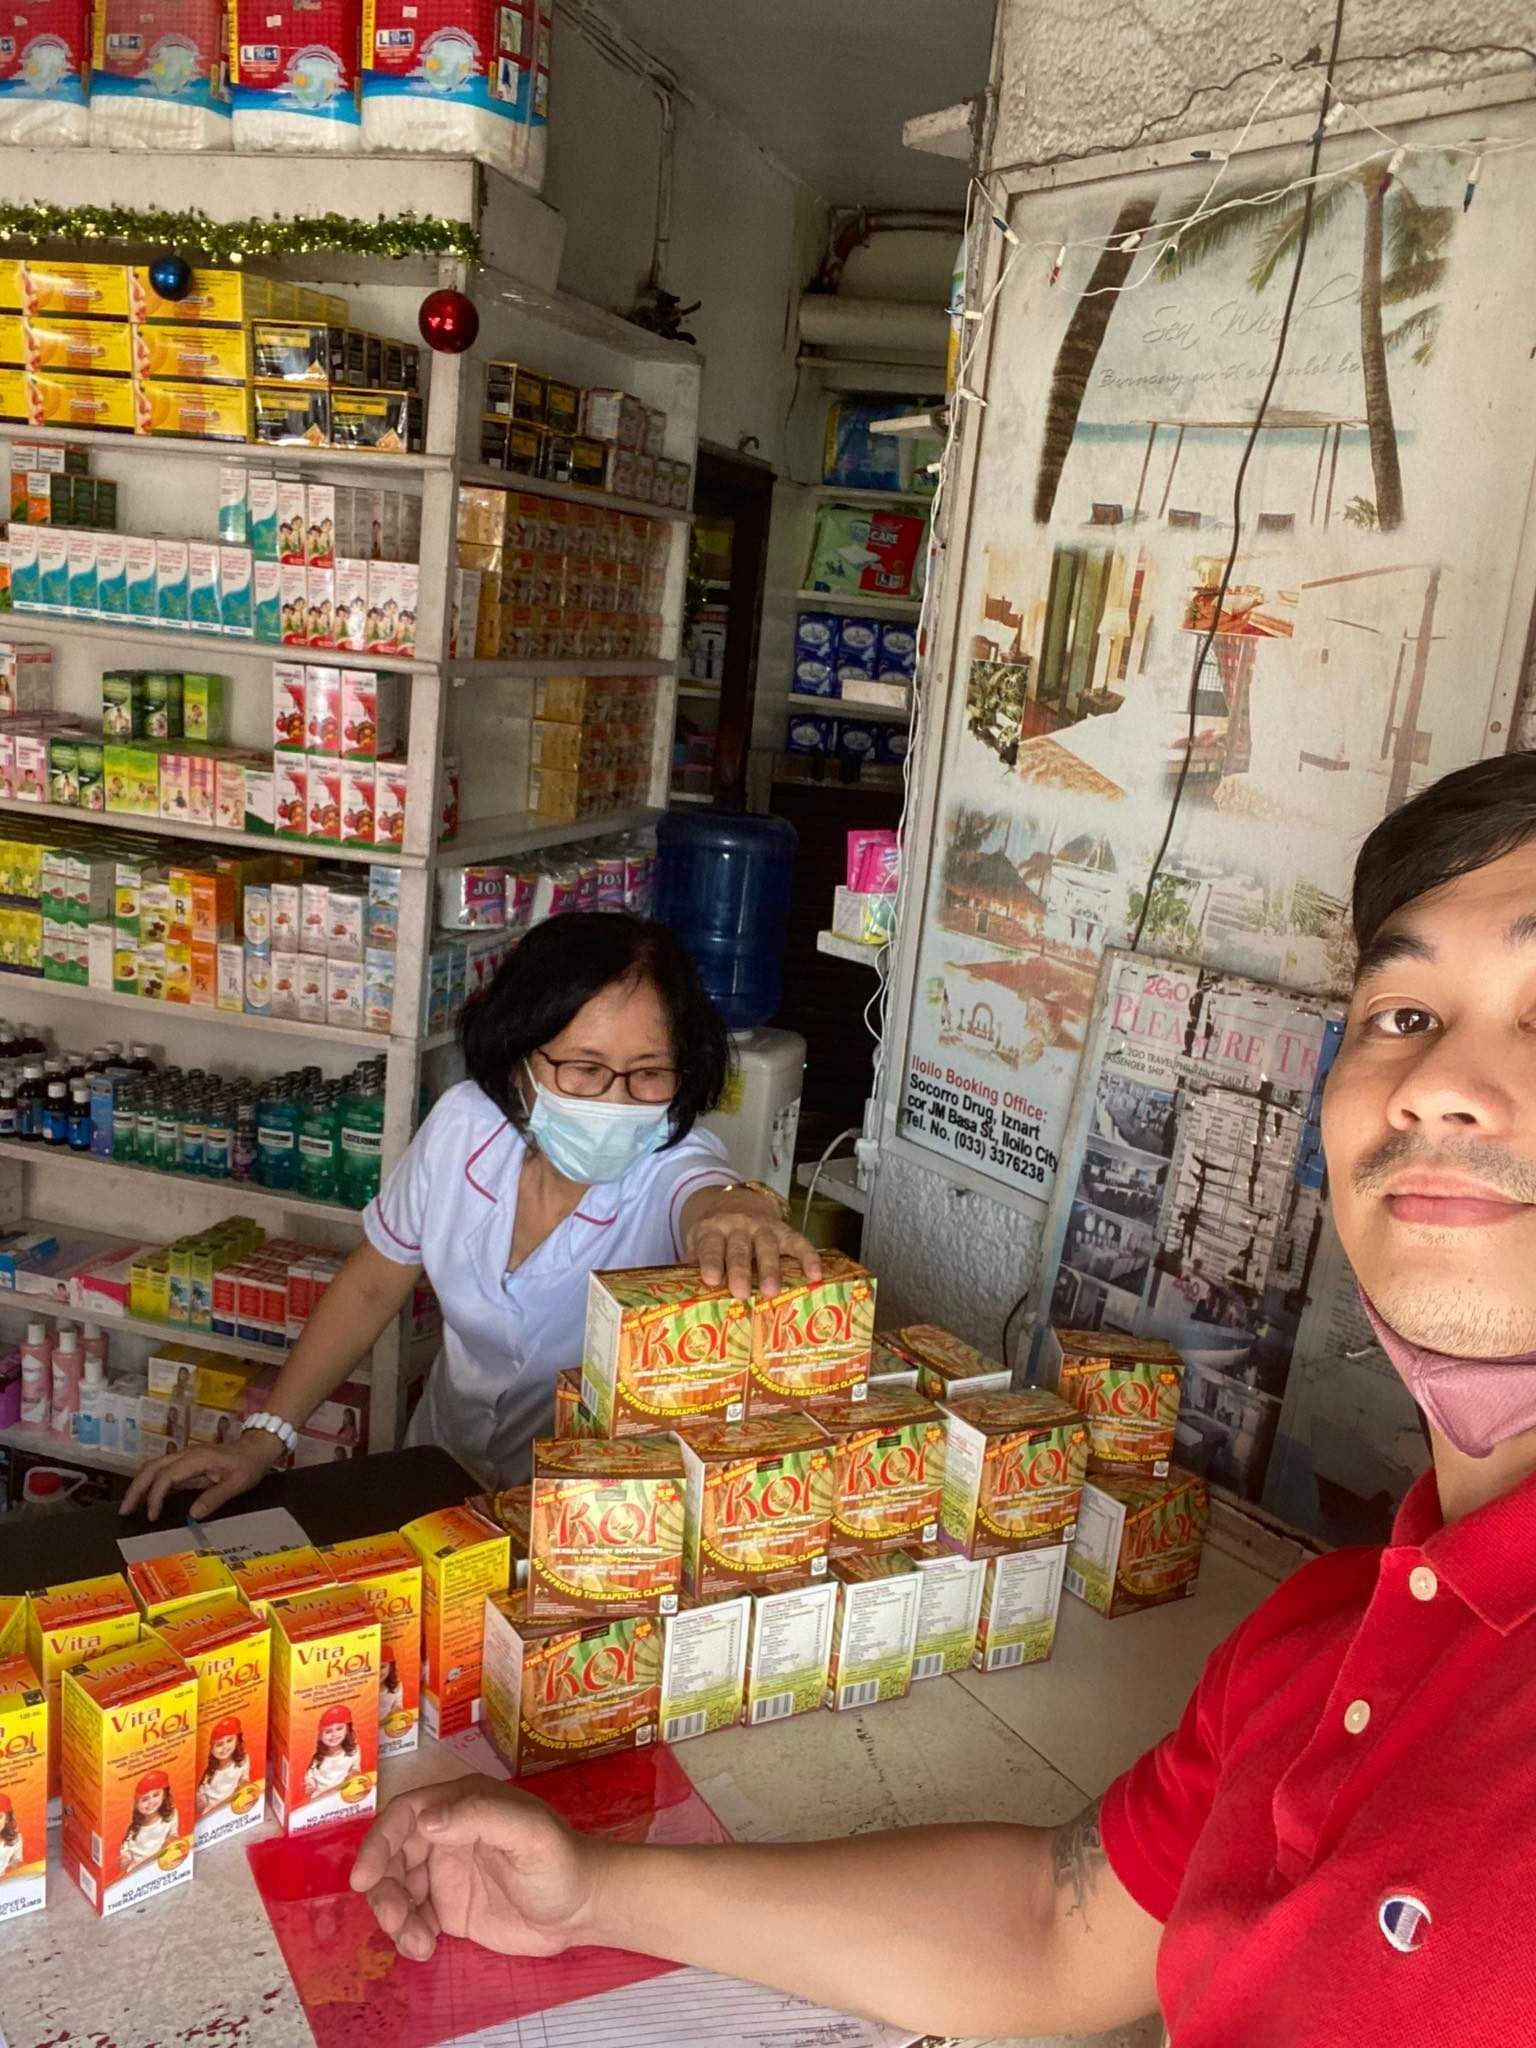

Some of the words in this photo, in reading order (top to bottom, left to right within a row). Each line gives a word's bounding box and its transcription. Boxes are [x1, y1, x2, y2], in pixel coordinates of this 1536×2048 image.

[1144, 976, 1190, 1000] 2GO
[1111, 992, 1265, 1068] PLEAURE
[910, 1074, 959, 1106] Socorro
[962, 1096, 997, 1125] Drug,
[1001, 1111, 1041, 1140] Iznart
[911, 1055, 942, 1080] Iloilo
[946, 1068, 999, 1106] Booking
[1003, 1092, 1047, 1123] Office:
[905, 1110, 926, 1131] Tel.
[930, 1120, 950, 1142] No.
[954, 1131, 986, 1161] (033)
[989, 1146, 1045, 1183] 3376238
[907, 1094, 926, 1111] cor
[928, 1103, 946, 1120] JM
[948, 1109, 977, 1133] Basa
[1002, 1130, 1032, 1157] Iloilo
[1035, 1145, 1059, 1173] City
[640, 1316, 731, 1371] KOI
[771, 1299, 855, 1351] KOI
[1077, 1373, 1161, 1421] KOI
[847, 1442, 928, 1495] KOI
[998, 1442, 1072, 1496] KOI
[724, 1469, 812, 1527] KOI
[557, 1502, 658, 1548] KOI
[363, 1588, 388, 1602] ta
[540, 1568, 584, 1597] APPROVED
[583, 1589, 643, 1600] THERAPEUTIC
[642, 1583, 675, 1598] CLAIMS
[50, 1634, 101, 1655] Vita
[297, 1645, 345, 1666] Vita
[544, 1638, 636, 1706] KOI
[111, 1707, 161, 1733] Vita
